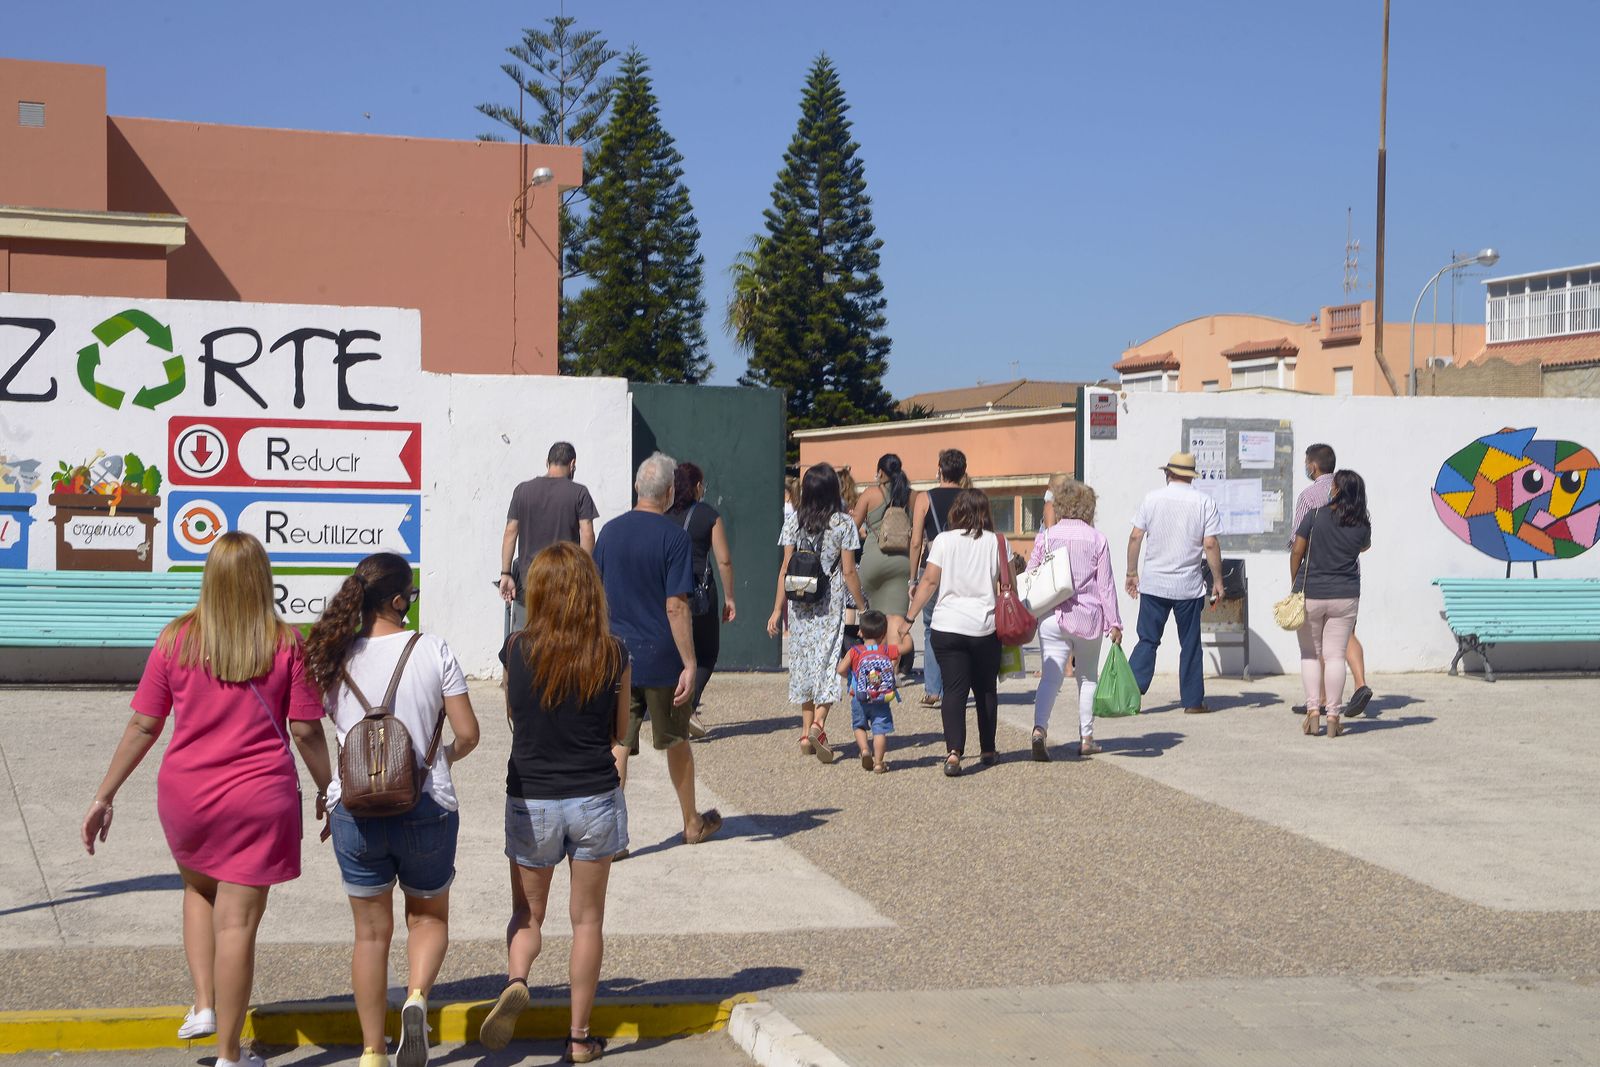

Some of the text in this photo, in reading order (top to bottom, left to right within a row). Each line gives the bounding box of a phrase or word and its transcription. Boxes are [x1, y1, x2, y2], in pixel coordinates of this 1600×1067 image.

[267, 437, 361, 472] Reducir
[72, 521, 135, 544] orgánico
[265, 510, 384, 545] Reutilizar
